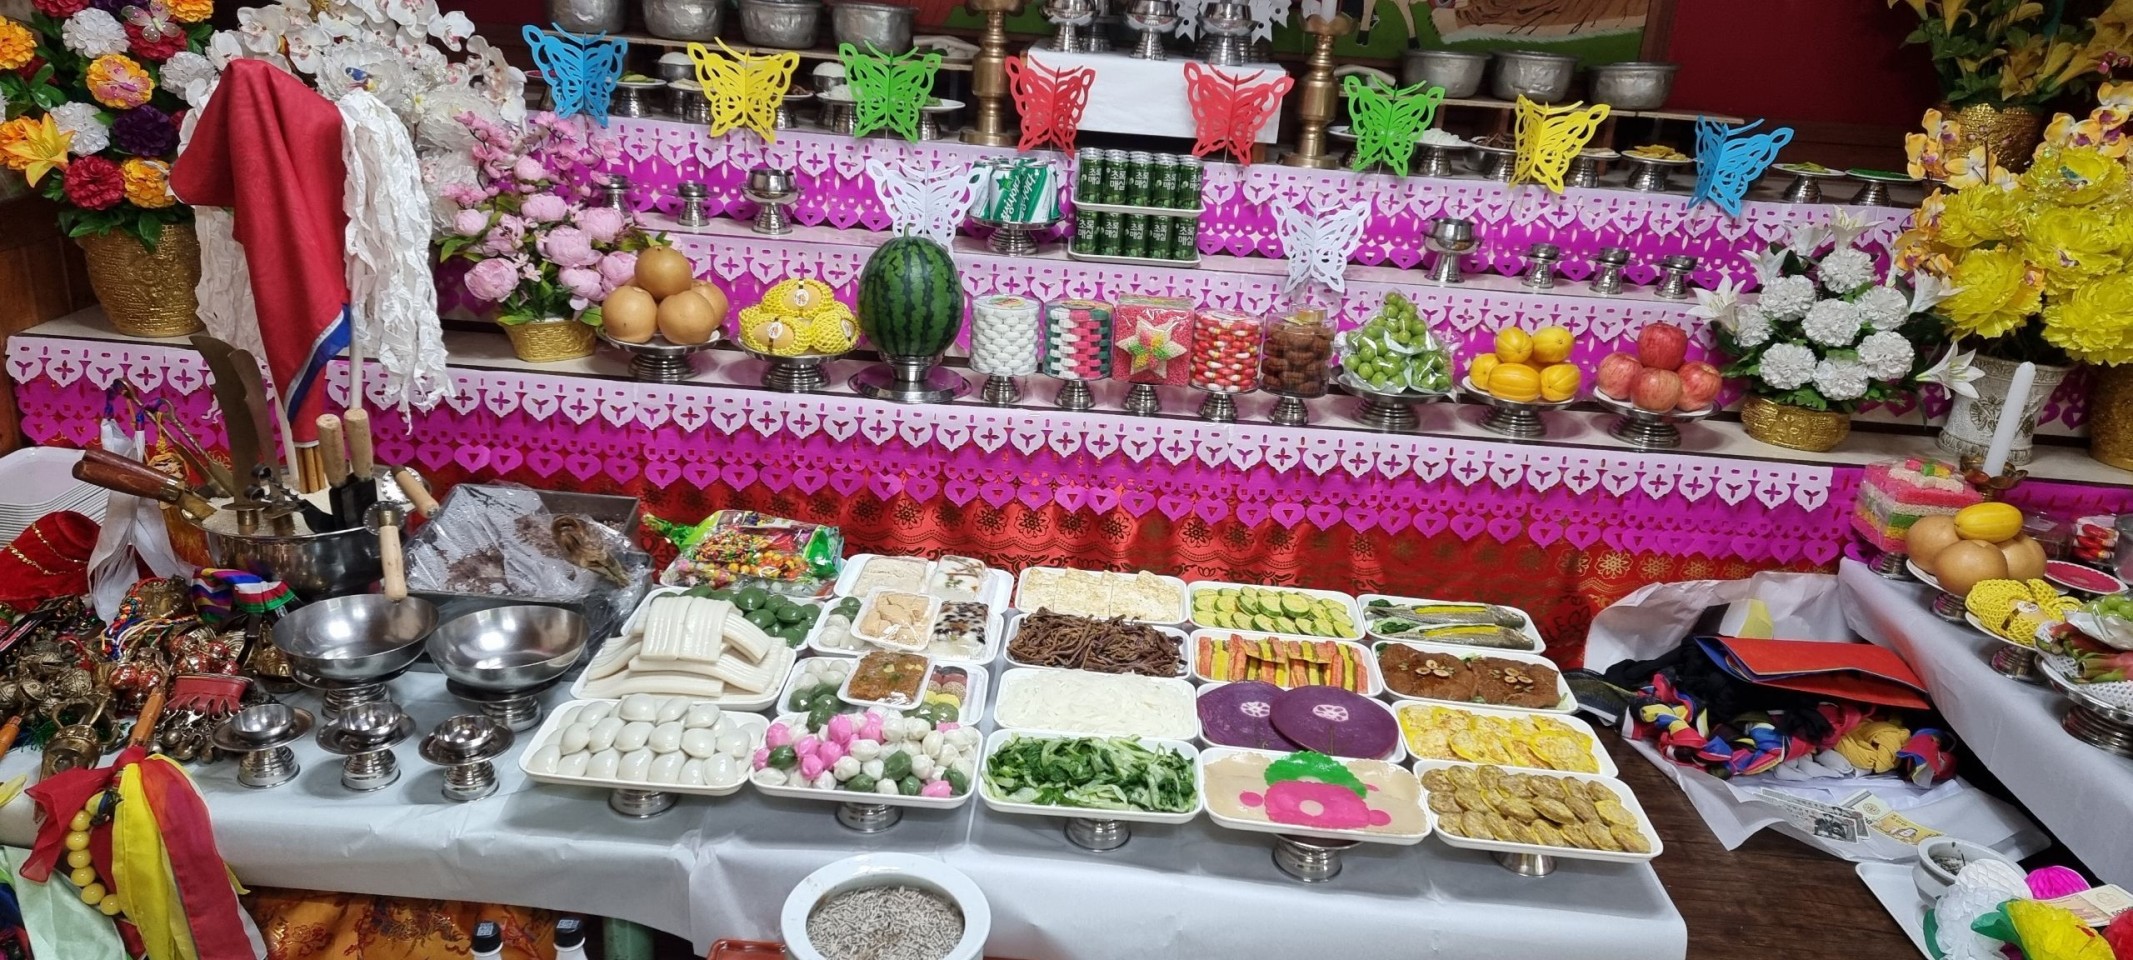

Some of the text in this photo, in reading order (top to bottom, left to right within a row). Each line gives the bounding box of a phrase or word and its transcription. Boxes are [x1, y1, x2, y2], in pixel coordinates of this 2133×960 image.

[1110, 169, 1126, 179] 초록
[1110, 180, 1126, 191] 매실
[1134, 179, 1149, 189] 매실
[1162, 181, 1176, 191] 매실
[1000, 174, 1021, 223] 칠성사이다
[1078, 219, 1094, 229] 초록
[1105, 221, 1119, 230] 초록
[1130, 222, 1144, 231] 초록
[1153, 224, 1168, 233] 초록
[1077, 228, 1094, 240] 매실
[1104, 229, 1119, 239] 매실
[1129, 230, 1144, 240] 매실
[1178, 226, 1195, 236] 초록
[1152, 231, 1167, 242] 매실
[1177, 234, 1194, 247] 매실
